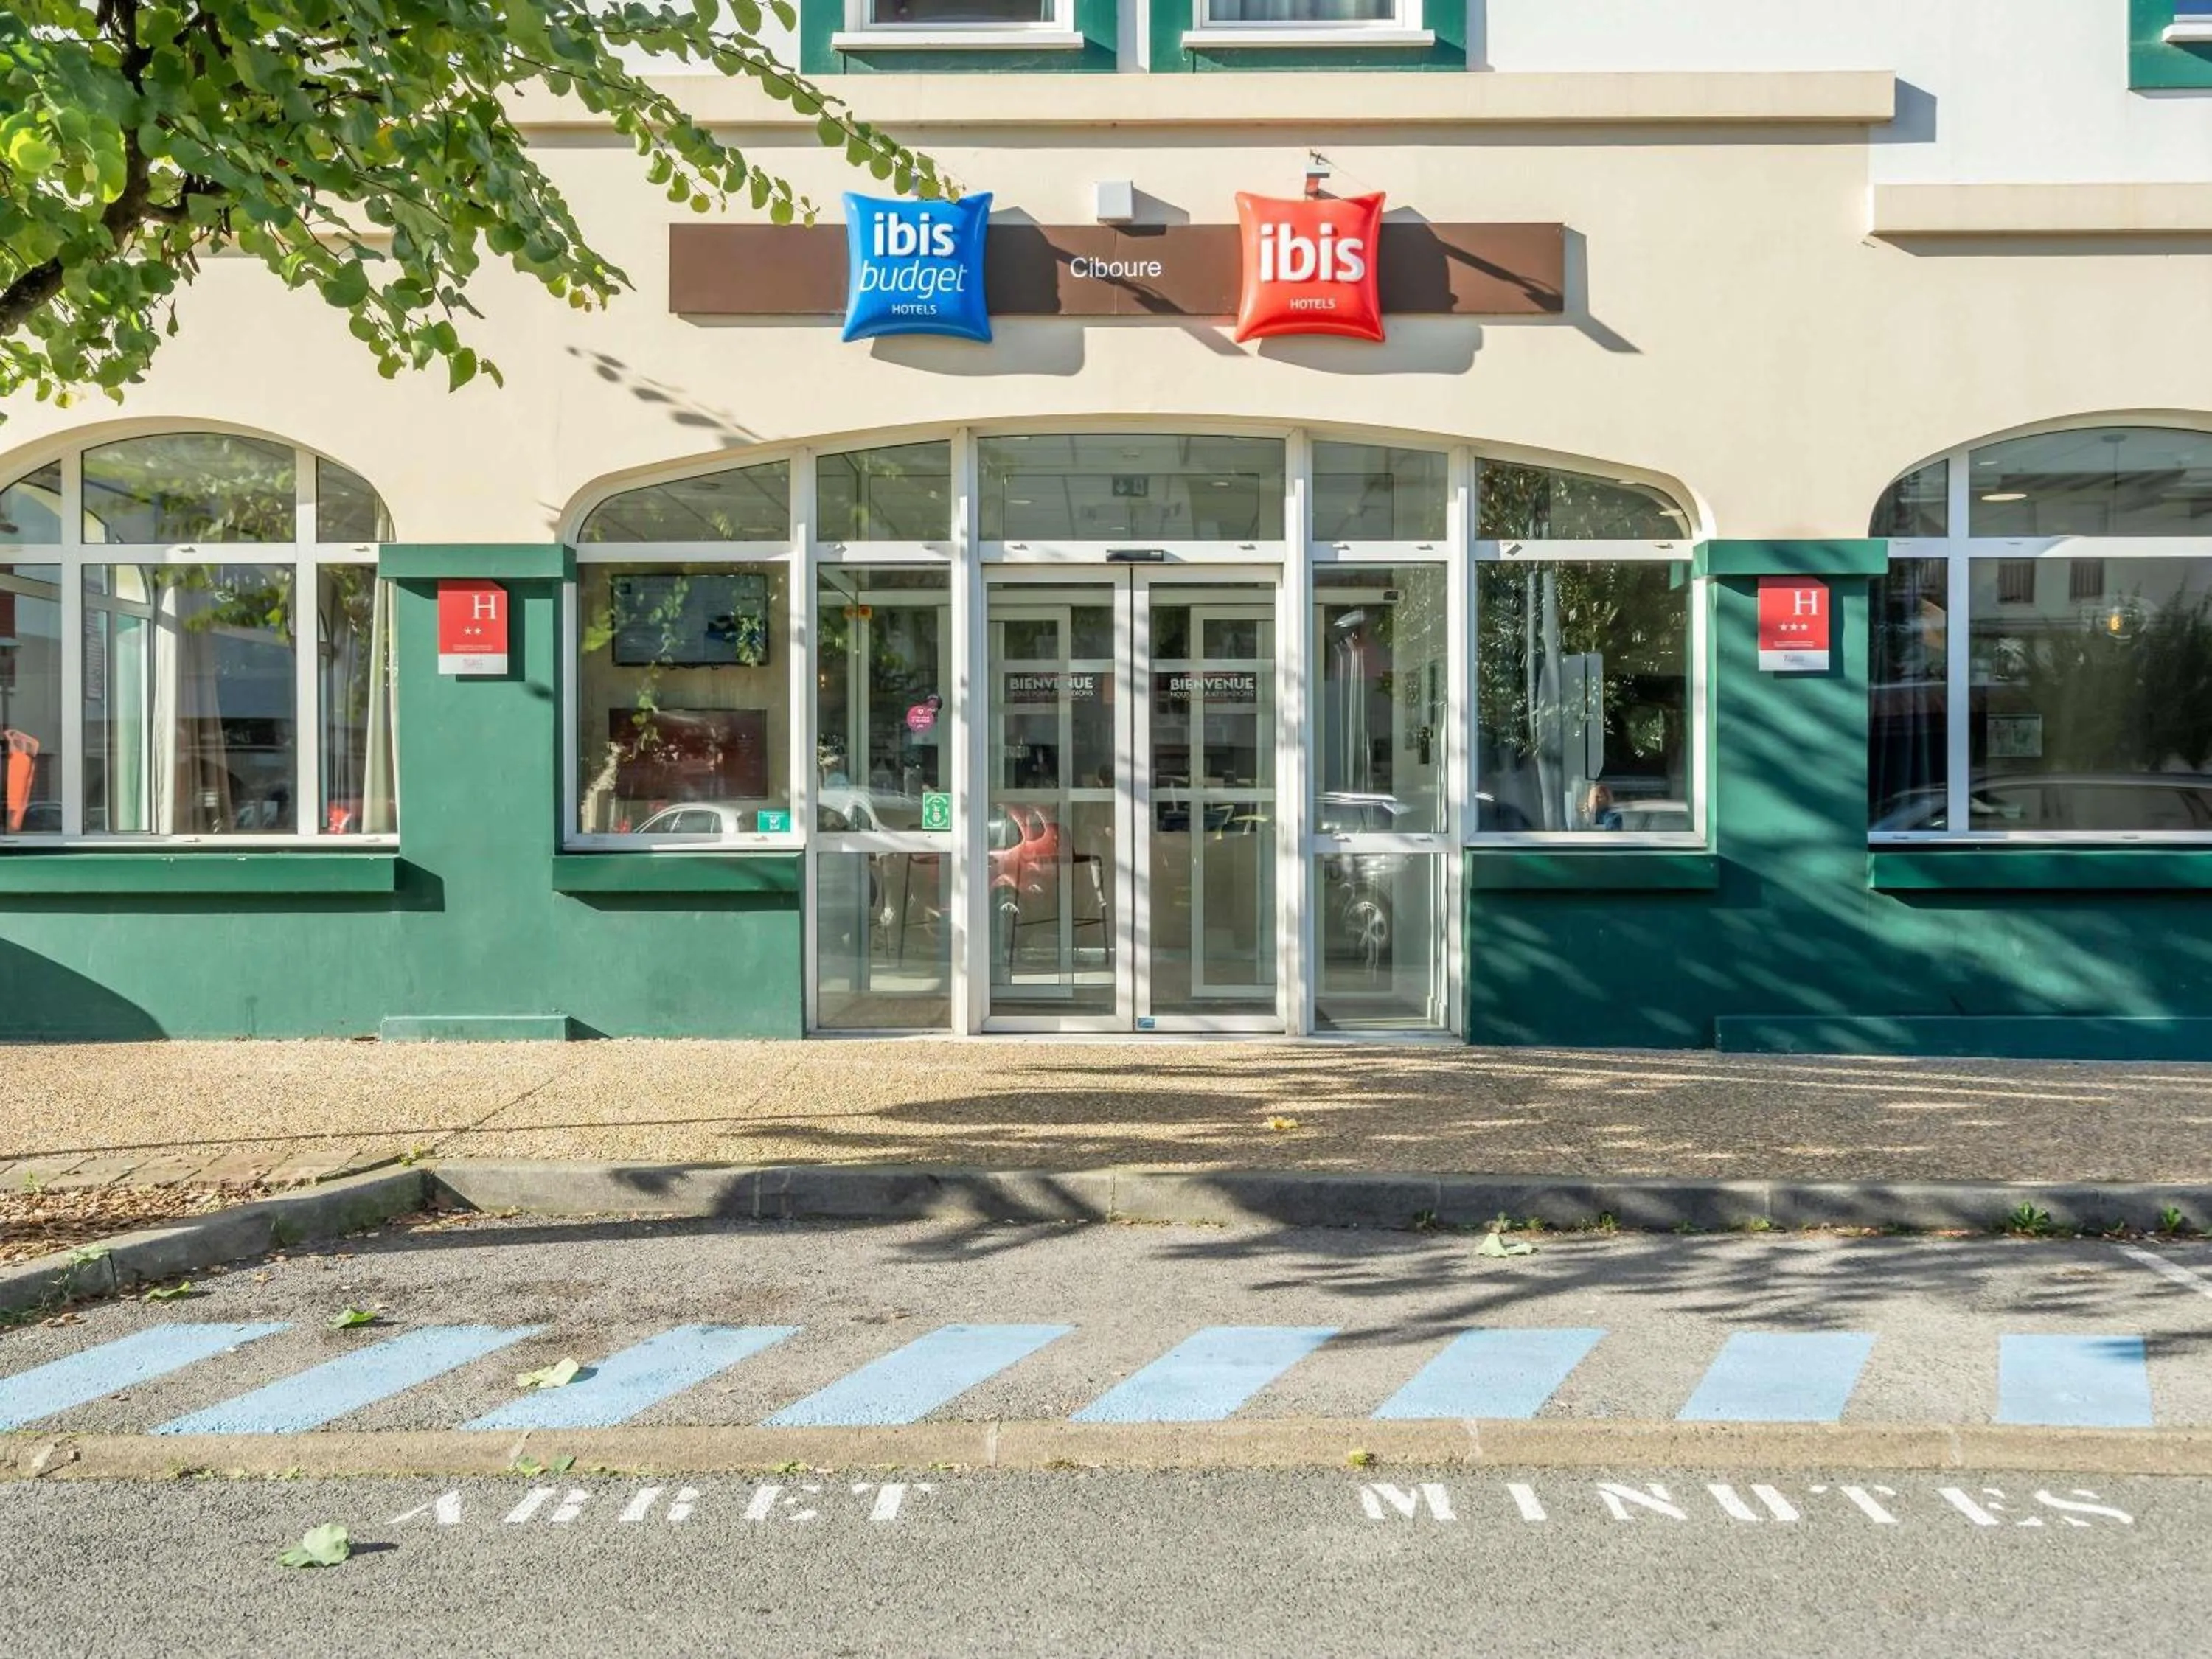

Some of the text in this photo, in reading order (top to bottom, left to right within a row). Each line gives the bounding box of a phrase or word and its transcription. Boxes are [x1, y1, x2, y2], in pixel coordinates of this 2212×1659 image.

[874, 212, 955, 257] ibis
[1259, 222, 1365, 282] ibis
[859, 259, 968, 299] budget
[1070, 257, 1162, 278] Ciboure
[891, 304, 938, 315] HOTELS
[1290, 298, 1336, 309] HOTELS
[473, 594, 495, 620] H
[1793, 590, 1818, 616] H
[1170, 678, 1254, 691] BIENVENUE
[1361, 1483, 2134, 1526] MINUTES
